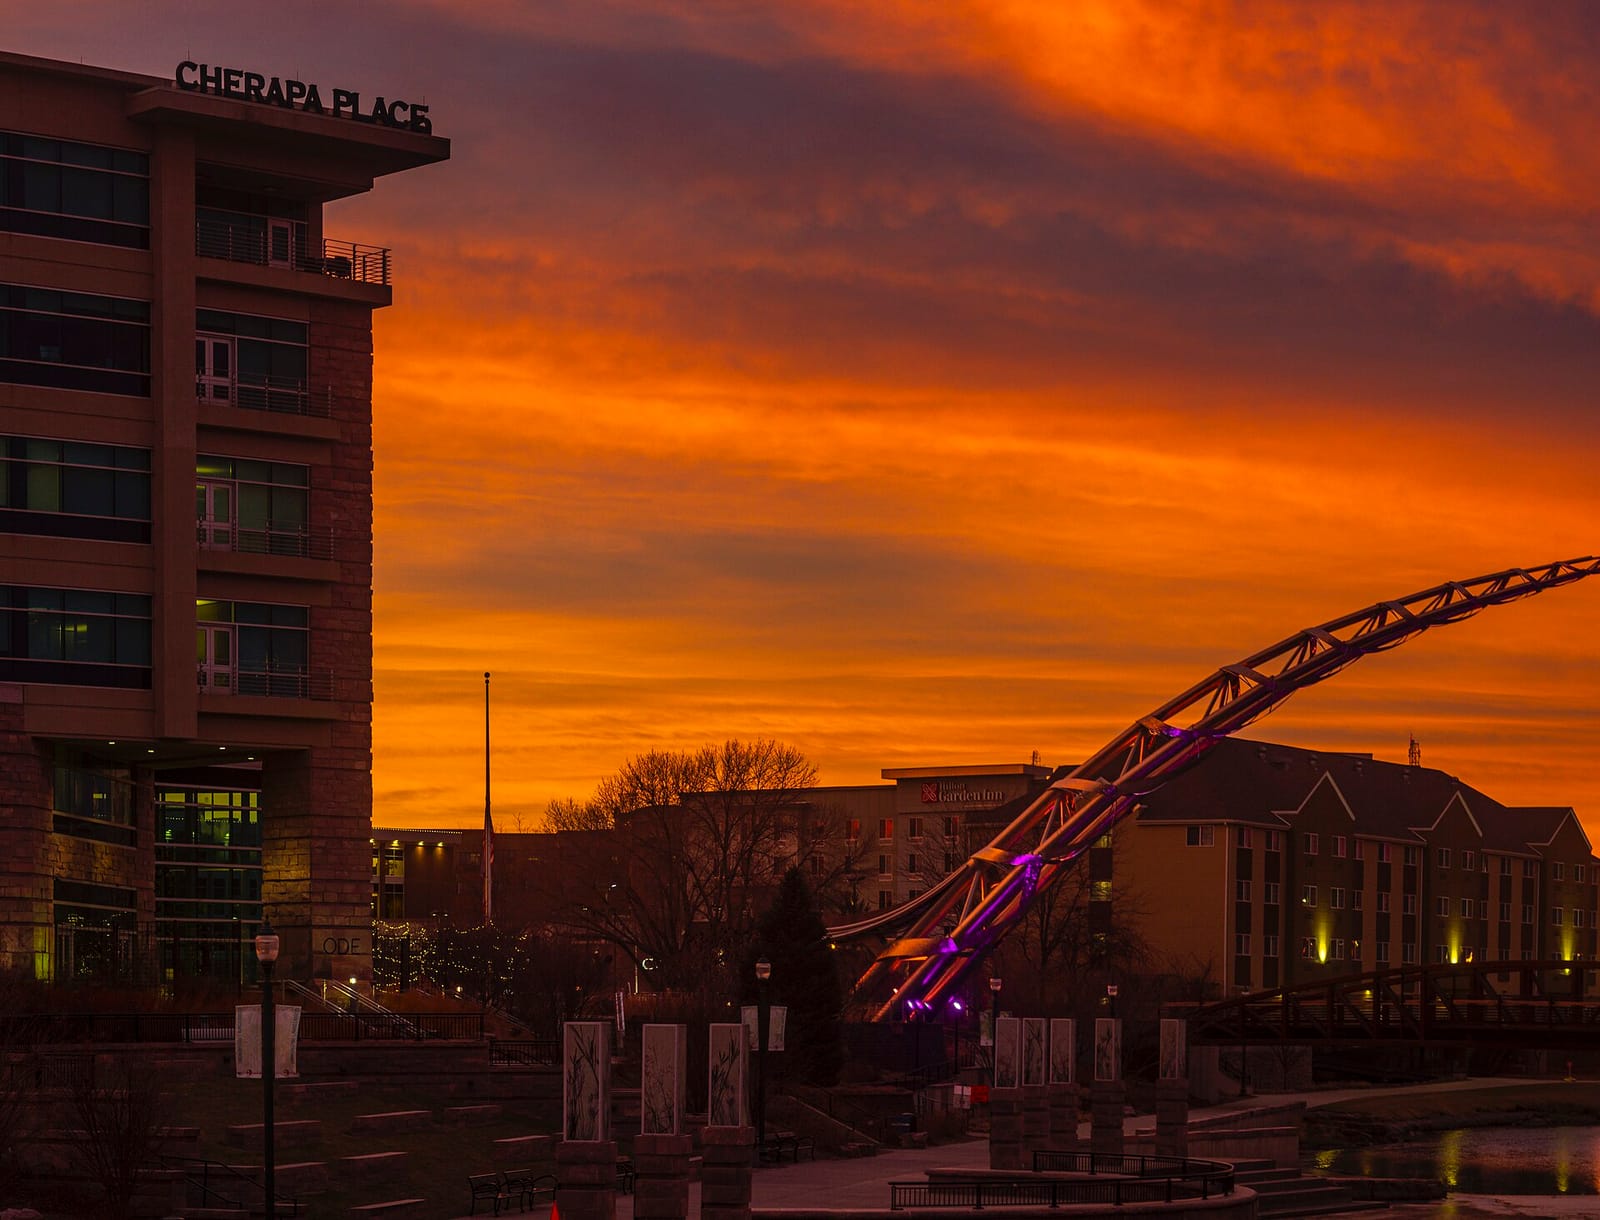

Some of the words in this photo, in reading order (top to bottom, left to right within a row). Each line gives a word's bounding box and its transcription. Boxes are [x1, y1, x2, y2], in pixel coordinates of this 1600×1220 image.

[175, 60, 323, 113] CHERAPA
[332, 88, 432, 135] PLACE
[939, 789, 981, 801] Garden
[982, 789, 1004, 801] Inn
[323, 937, 361, 955] ODE
